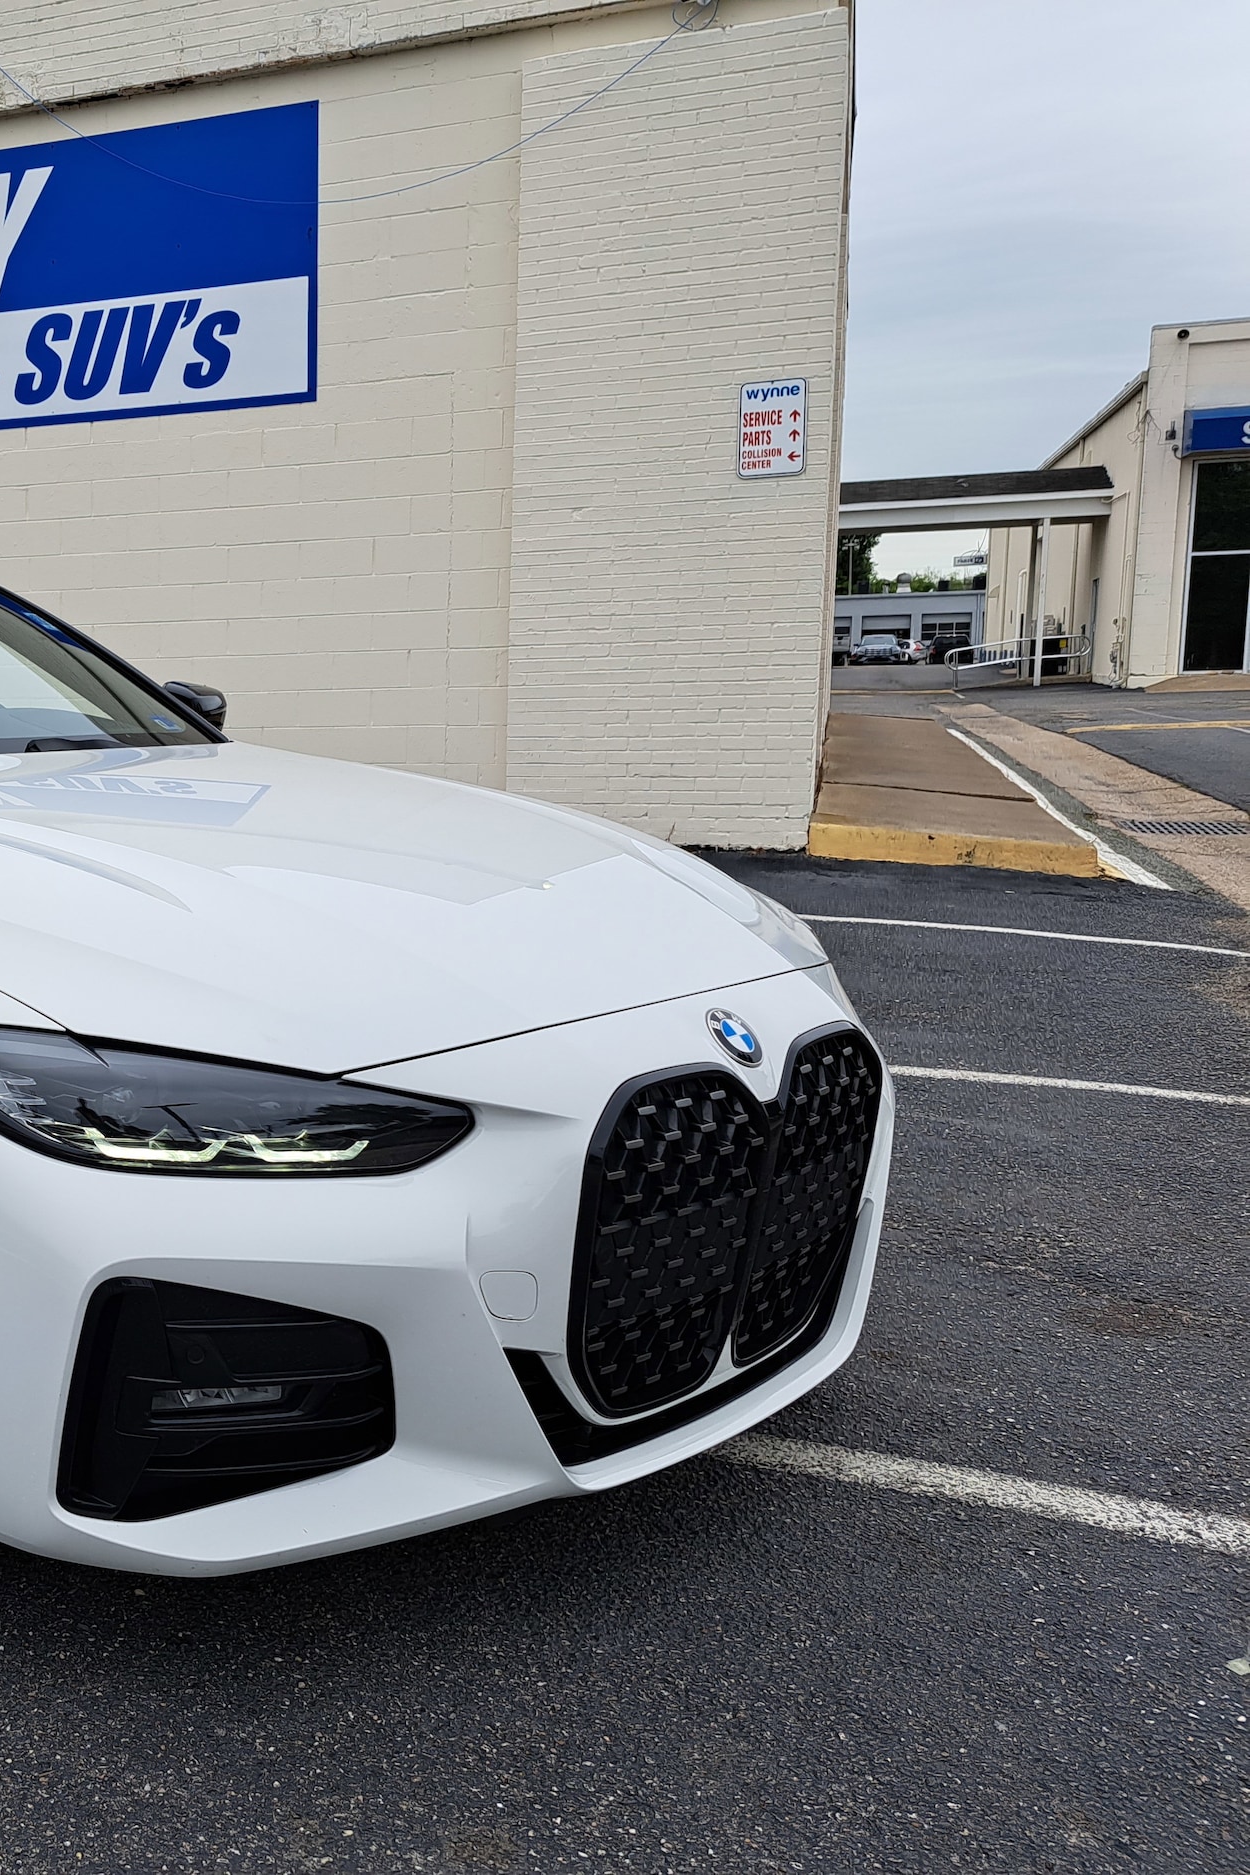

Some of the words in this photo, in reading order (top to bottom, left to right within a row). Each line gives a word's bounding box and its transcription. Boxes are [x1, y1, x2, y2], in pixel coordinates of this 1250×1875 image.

[746, 385, 800, 402] wynne
[742, 409, 783, 428] SERVICE
[742, 430, 772, 447] PARTS
[741, 448, 782, 460] COLLISION
[741, 460, 771, 470] CENTER
